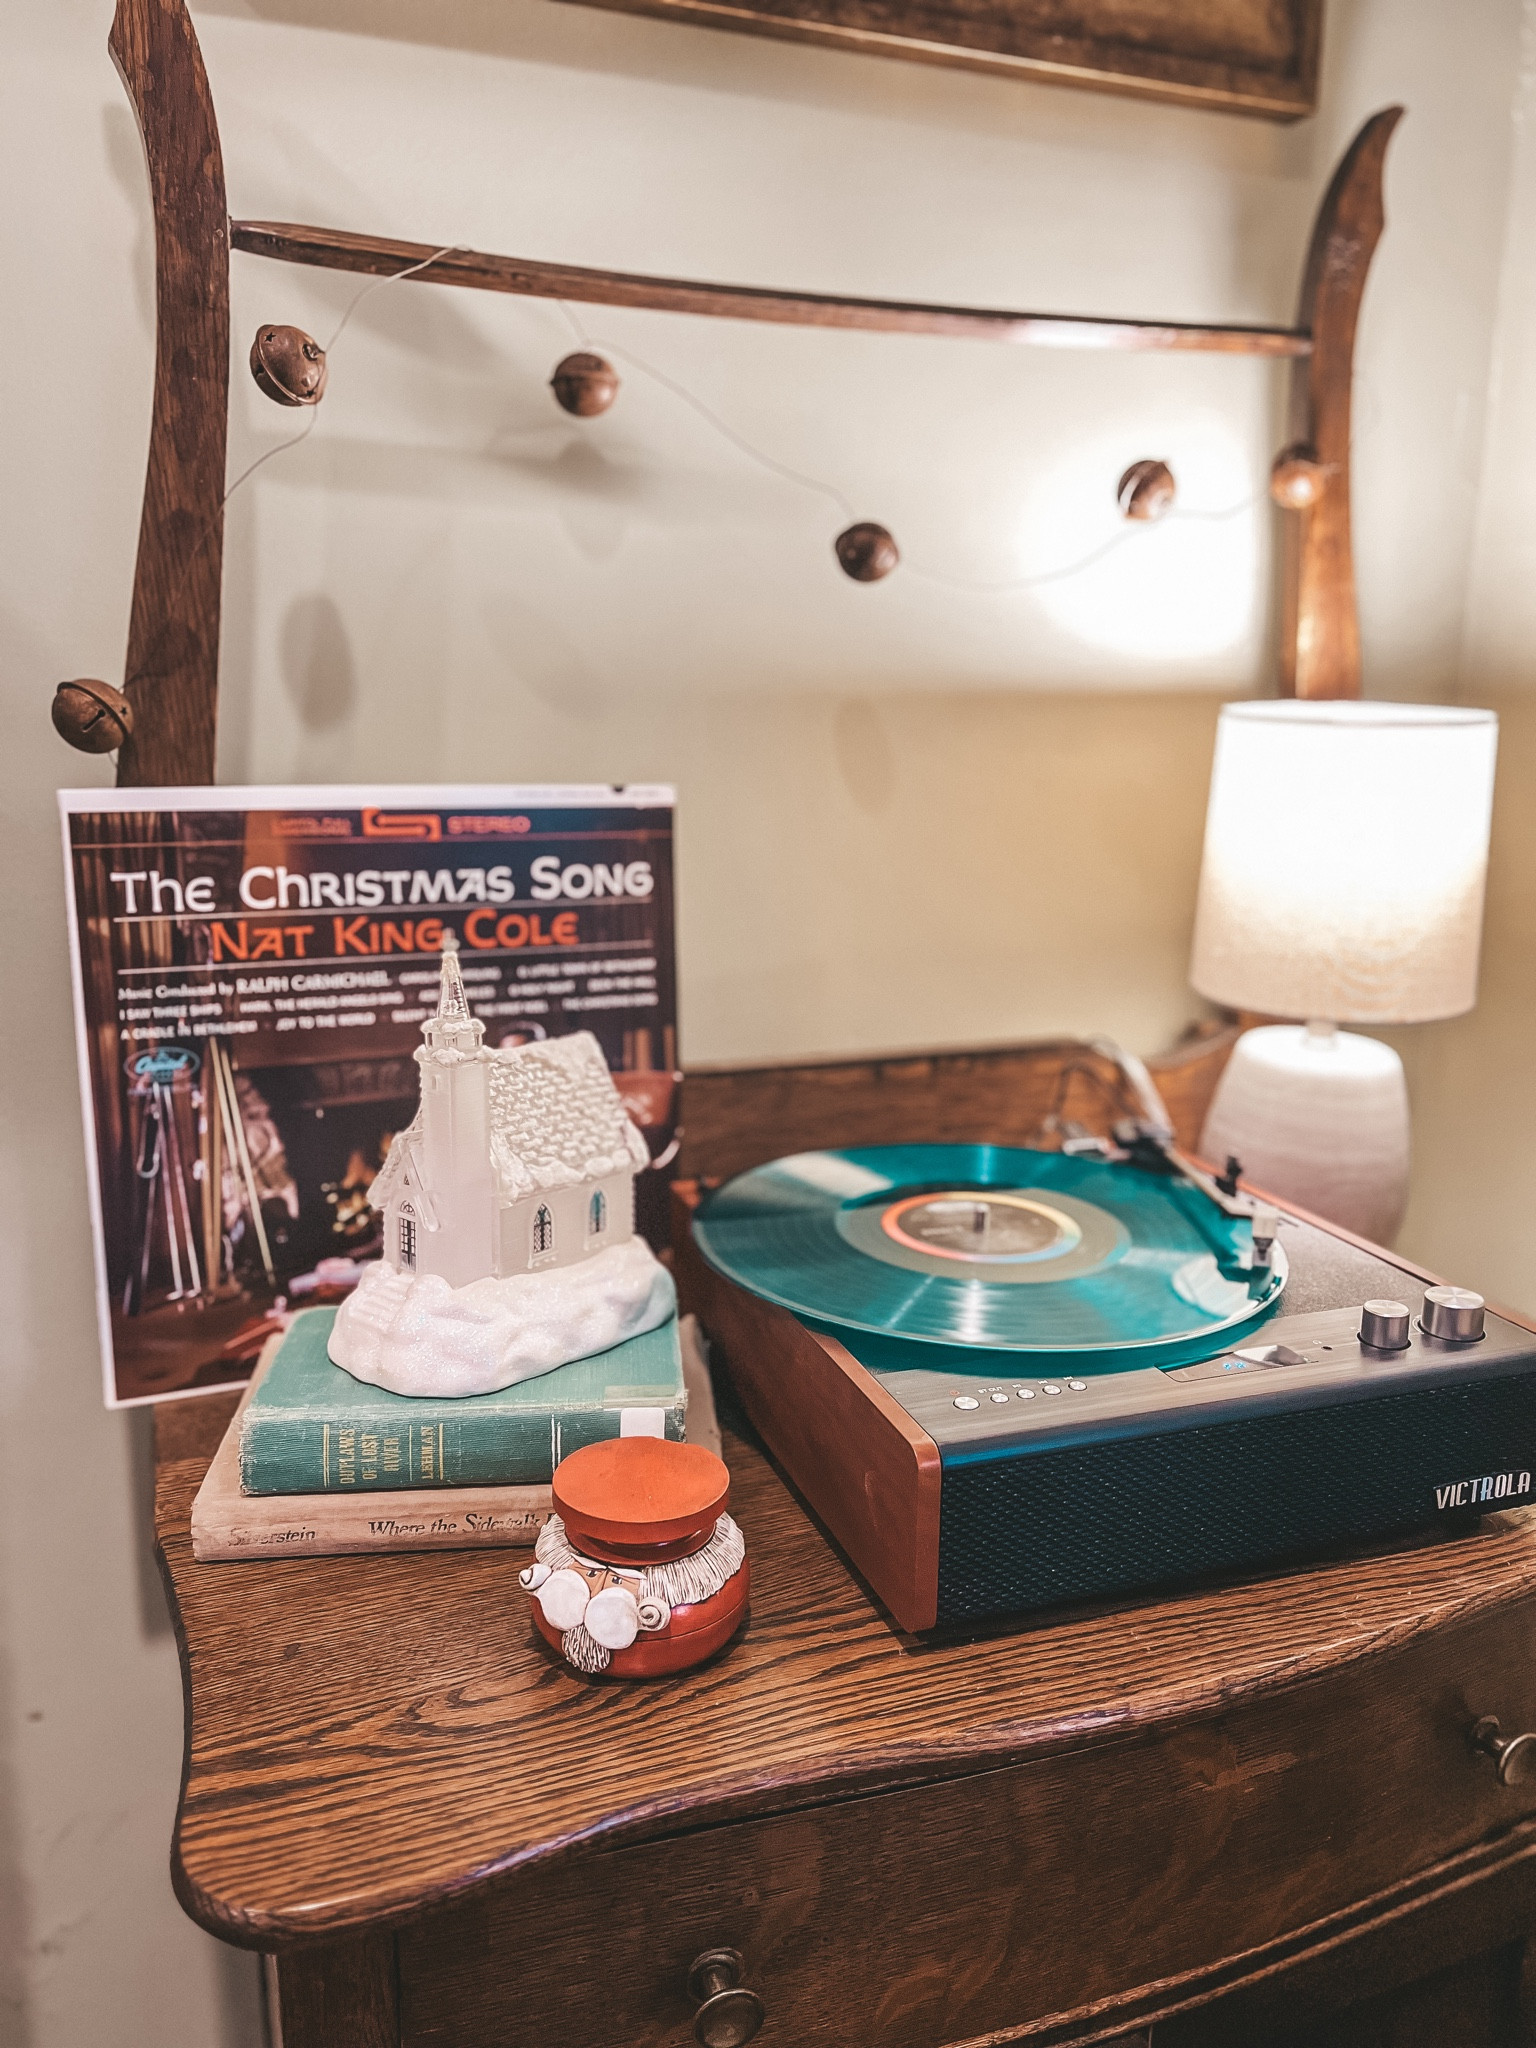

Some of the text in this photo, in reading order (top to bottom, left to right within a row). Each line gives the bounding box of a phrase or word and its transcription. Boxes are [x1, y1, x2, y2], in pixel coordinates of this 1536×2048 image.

[447, 814, 532, 835] STEREO
[109, 869, 217, 914] The
[235, 978, 290, 995] RALPH
[338, 1428, 356, 1485] OUTLAWS
[361, 1433, 379, 1481] OF LOST
[383, 1436, 401, 1473] RIVER
[420, 1425, 434, 1481] LEHMAN
[1435, 1471, 1532, 1511] VICTROLA
[368, 1519, 426, 1537] Where
[430, 1518, 458, 1534] the
